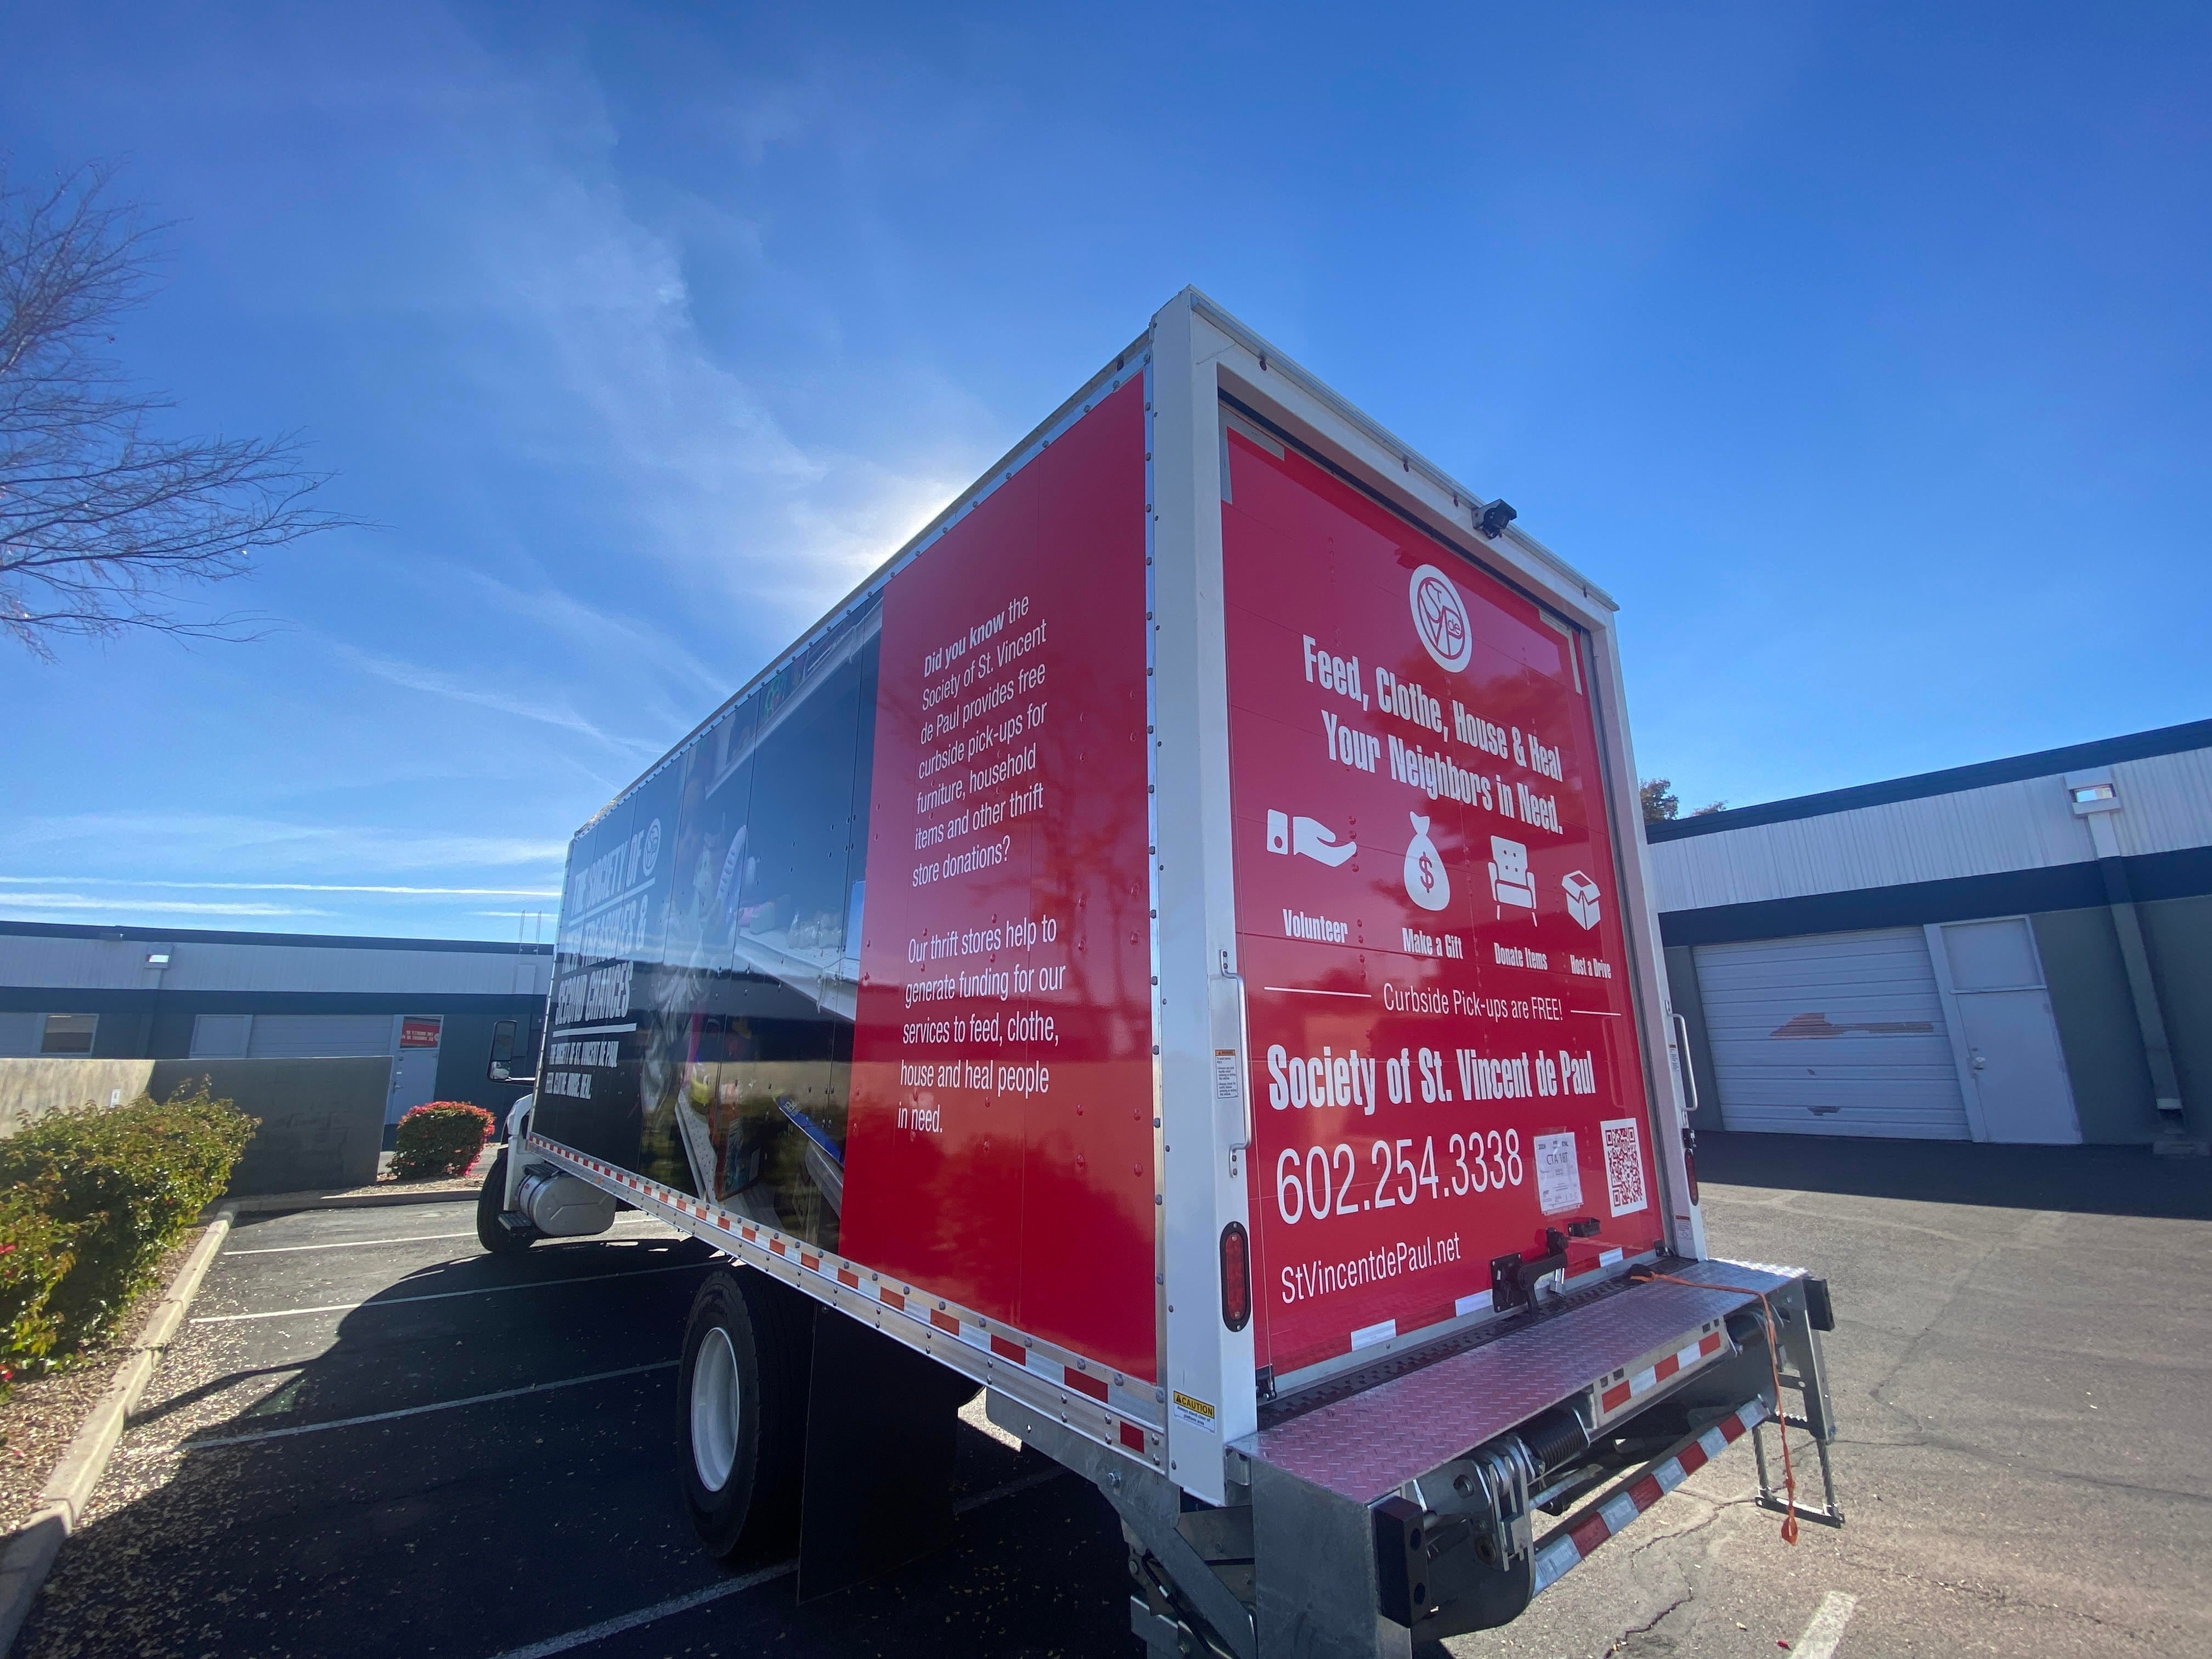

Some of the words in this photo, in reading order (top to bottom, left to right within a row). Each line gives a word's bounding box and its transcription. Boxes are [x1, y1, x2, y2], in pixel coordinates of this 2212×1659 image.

[922, 673, 961, 711] Society
[963, 659, 975, 687] of
[978, 652, 994, 679] St.
[997, 619, 1047, 668] Vincent
[924, 647, 942, 678] Did
[945, 636, 966, 669] you
[969, 611, 1005, 649] know
[1008, 596, 1029, 624] the
[921, 721, 933, 745] de
[936, 704, 960, 737] Paul
[963, 680, 1014, 729] provides
[1018, 663, 1046, 695] free
[1303, 634, 1369, 711] Feed,
[1375, 667, 1448, 742] Clothe,
[1453, 699, 1508, 760] House
[1512, 726, 1527, 768] &
[1528, 733, 1563, 782] Heal
[918, 740, 965, 780] curbside
[968, 714, 1023, 762] pick-ups
[1027, 702, 1047, 730] for
[1321, 709, 1381, 774] Your
[1387, 734, 1493, 811] Neighbors
[1496, 774, 1515, 819] in
[1516, 782, 1564, 834] Need.
[917, 780, 966, 815] furniture,
[969, 742, 1036, 794] household
[915, 823, 944, 850] items
[947, 809, 969, 839] and
[972, 800, 1006, 831] other
[1009, 782, 1043, 818] thrift
[587, 840, 628, 909] SOCIETY
[627, 829, 645, 888] OF
[912, 862, 939, 887] store
[943, 834, 1011, 879] donations?
[635, 894, 648, 951] &
[908, 938, 928, 963] Our
[930, 930, 958, 960] thrift
[961, 928, 1001, 955] stores
[1005, 917, 1036, 951] help
[1041, 914, 1057, 943] to
[1282, 908, 1348, 943] Volunteer
[1402, 927, 1433, 955] Make
[1435, 936, 1443, 957] a
[1444, 934, 1464, 960] Gift
[905, 974, 955, 1009] generate
[959, 968, 1009, 1001] funding
[1013, 963, 1035, 993] for
[1039, 965, 1066, 991] our
[1493, 942, 1523, 968] Donate
[1525, 947, 1548, 970] Items
[1570, 955, 1587, 976] Host
[1587, 961, 1593, 977] a
[1593, 958, 1612, 979] Drive
[555, 974, 588, 1025] SECOND
[585, 960, 634, 1022] CHANCES
[1383, 983, 1449, 1014] Curbside
[1453, 989, 1508, 1023] Pick-ups
[1511, 999, 1528, 1019] are
[1531, 996, 1563, 1021] FREE!
[903, 1017, 950, 1044] services
[953, 1015, 966, 1042] to
[970, 1012, 1002, 1047] feed,
[1008, 1010, 1058, 1046] clothe,
[900, 1059, 934, 1087] house
[938, 1059, 961, 1088] and
[965, 1059, 993, 1089] heal
[998, 1060, 1049, 1099] people
[1267, 1044, 1375, 1115] Society
[1386, 1048, 1412, 1104] of
[1418, 1047, 1453, 1103] St.
[1456, 1049, 1533, 1101] Vincent
[1535, 1050, 1558, 1097] de
[1559, 1050, 1596, 1095] Paul
[898, 1102, 907, 1128] in
[911, 1104, 943, 1133] need.
[1276, 1128, 1523, 1224] 602.254.3338
[1280, 1232, 1462, 1304] StVincentdePaul.net
[1182, 1397, 1213, 1415] CAUTION
